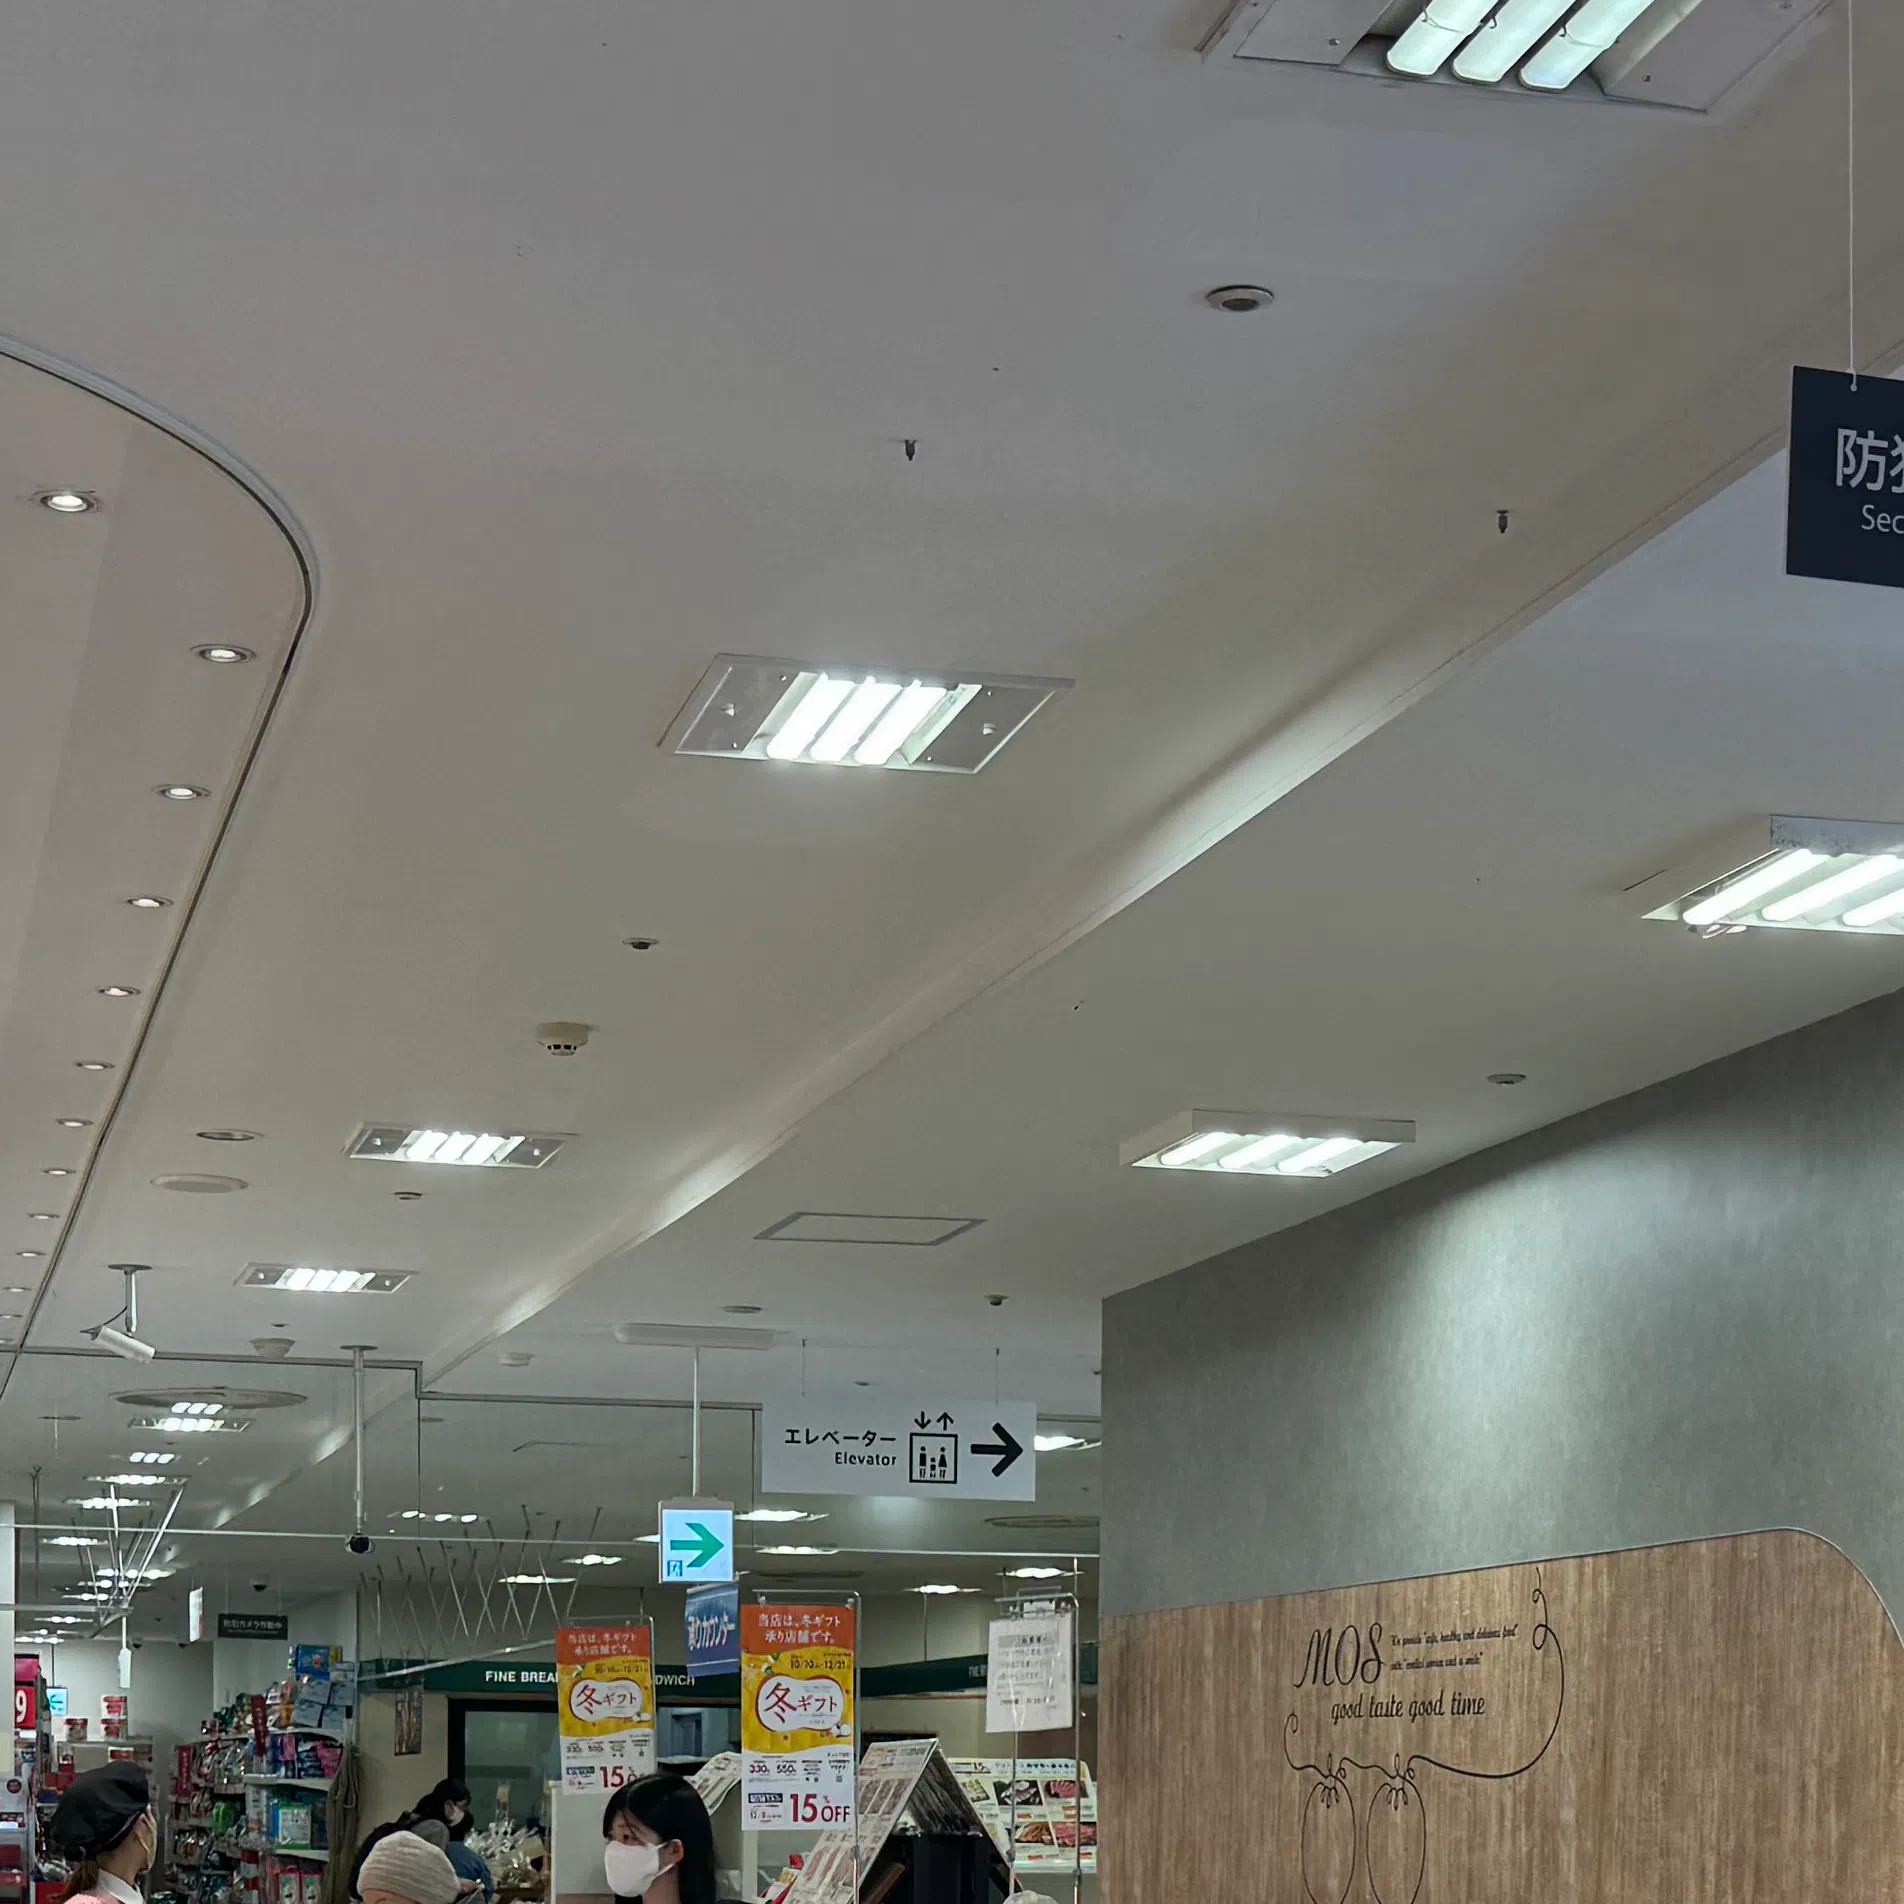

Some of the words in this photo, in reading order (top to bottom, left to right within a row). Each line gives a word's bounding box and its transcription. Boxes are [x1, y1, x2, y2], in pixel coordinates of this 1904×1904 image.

[785, 1428, 896, 1447] エレベーター
[835, 1452, 897, 1466] Elevator
[759, 1613, 841, 1627] 当店は、冬ギフト
[765, 1630, 834, 1644] 承り店舗です。
[1293, 1622, 1384, 1688] MOS
[485, 1671, 516, 1683] FINE
[576, 1684, 637, 1715] 冬ギフト
[763, 1682, 837, 1724] 冬ギフト
[1331, 1694, 1365, 1724] good
[1369, 1693, 1403, 1720] taste
[1408, 1690, 1445, 1723] good
[1450, 1691, 1485, 1716] time
[600, 1766, 624, 1788] 15
[790, 1794, 818, 1823] 15
[821, 1806, 851, 1823] OFF
